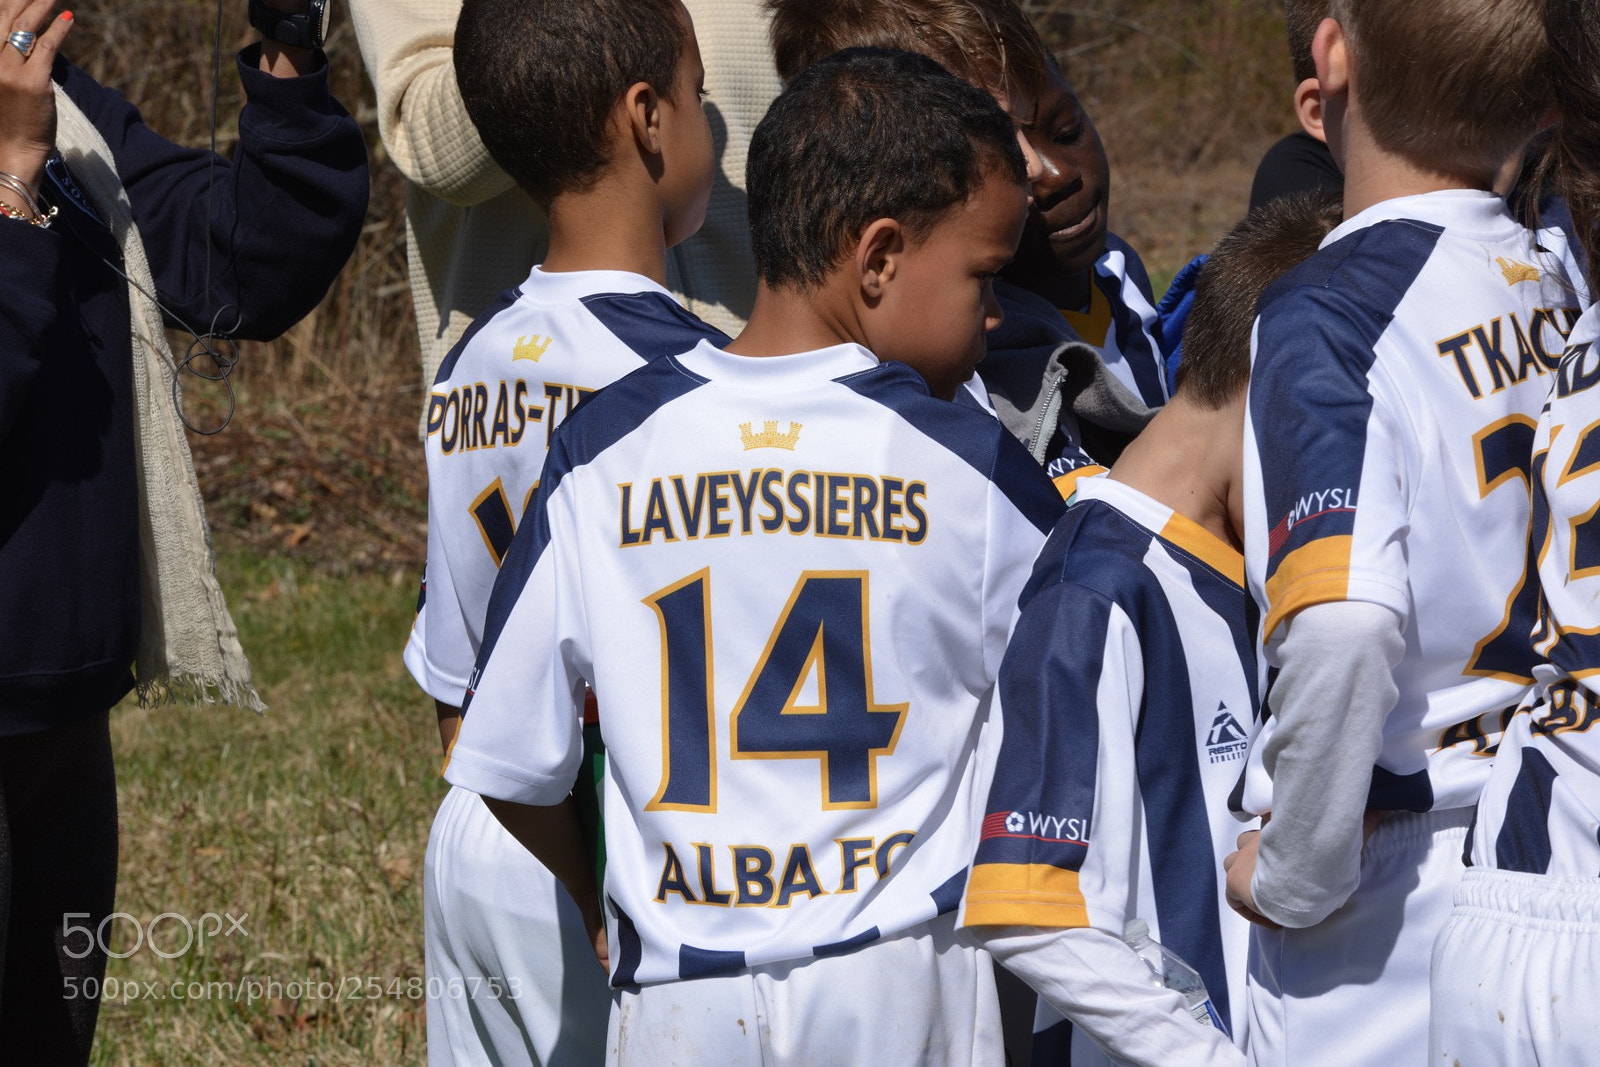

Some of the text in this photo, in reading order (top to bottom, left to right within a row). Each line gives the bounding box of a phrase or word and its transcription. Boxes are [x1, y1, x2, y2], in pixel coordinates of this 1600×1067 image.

[618, 468, 929, 548] LAVEYSSIERES
[1295, 488, 1357, 522] WYSL
[640, 566, 911, 814] 14
[1028, 811, 1090, 844] WYSL
[652, 841, 831, 909] ALBA
